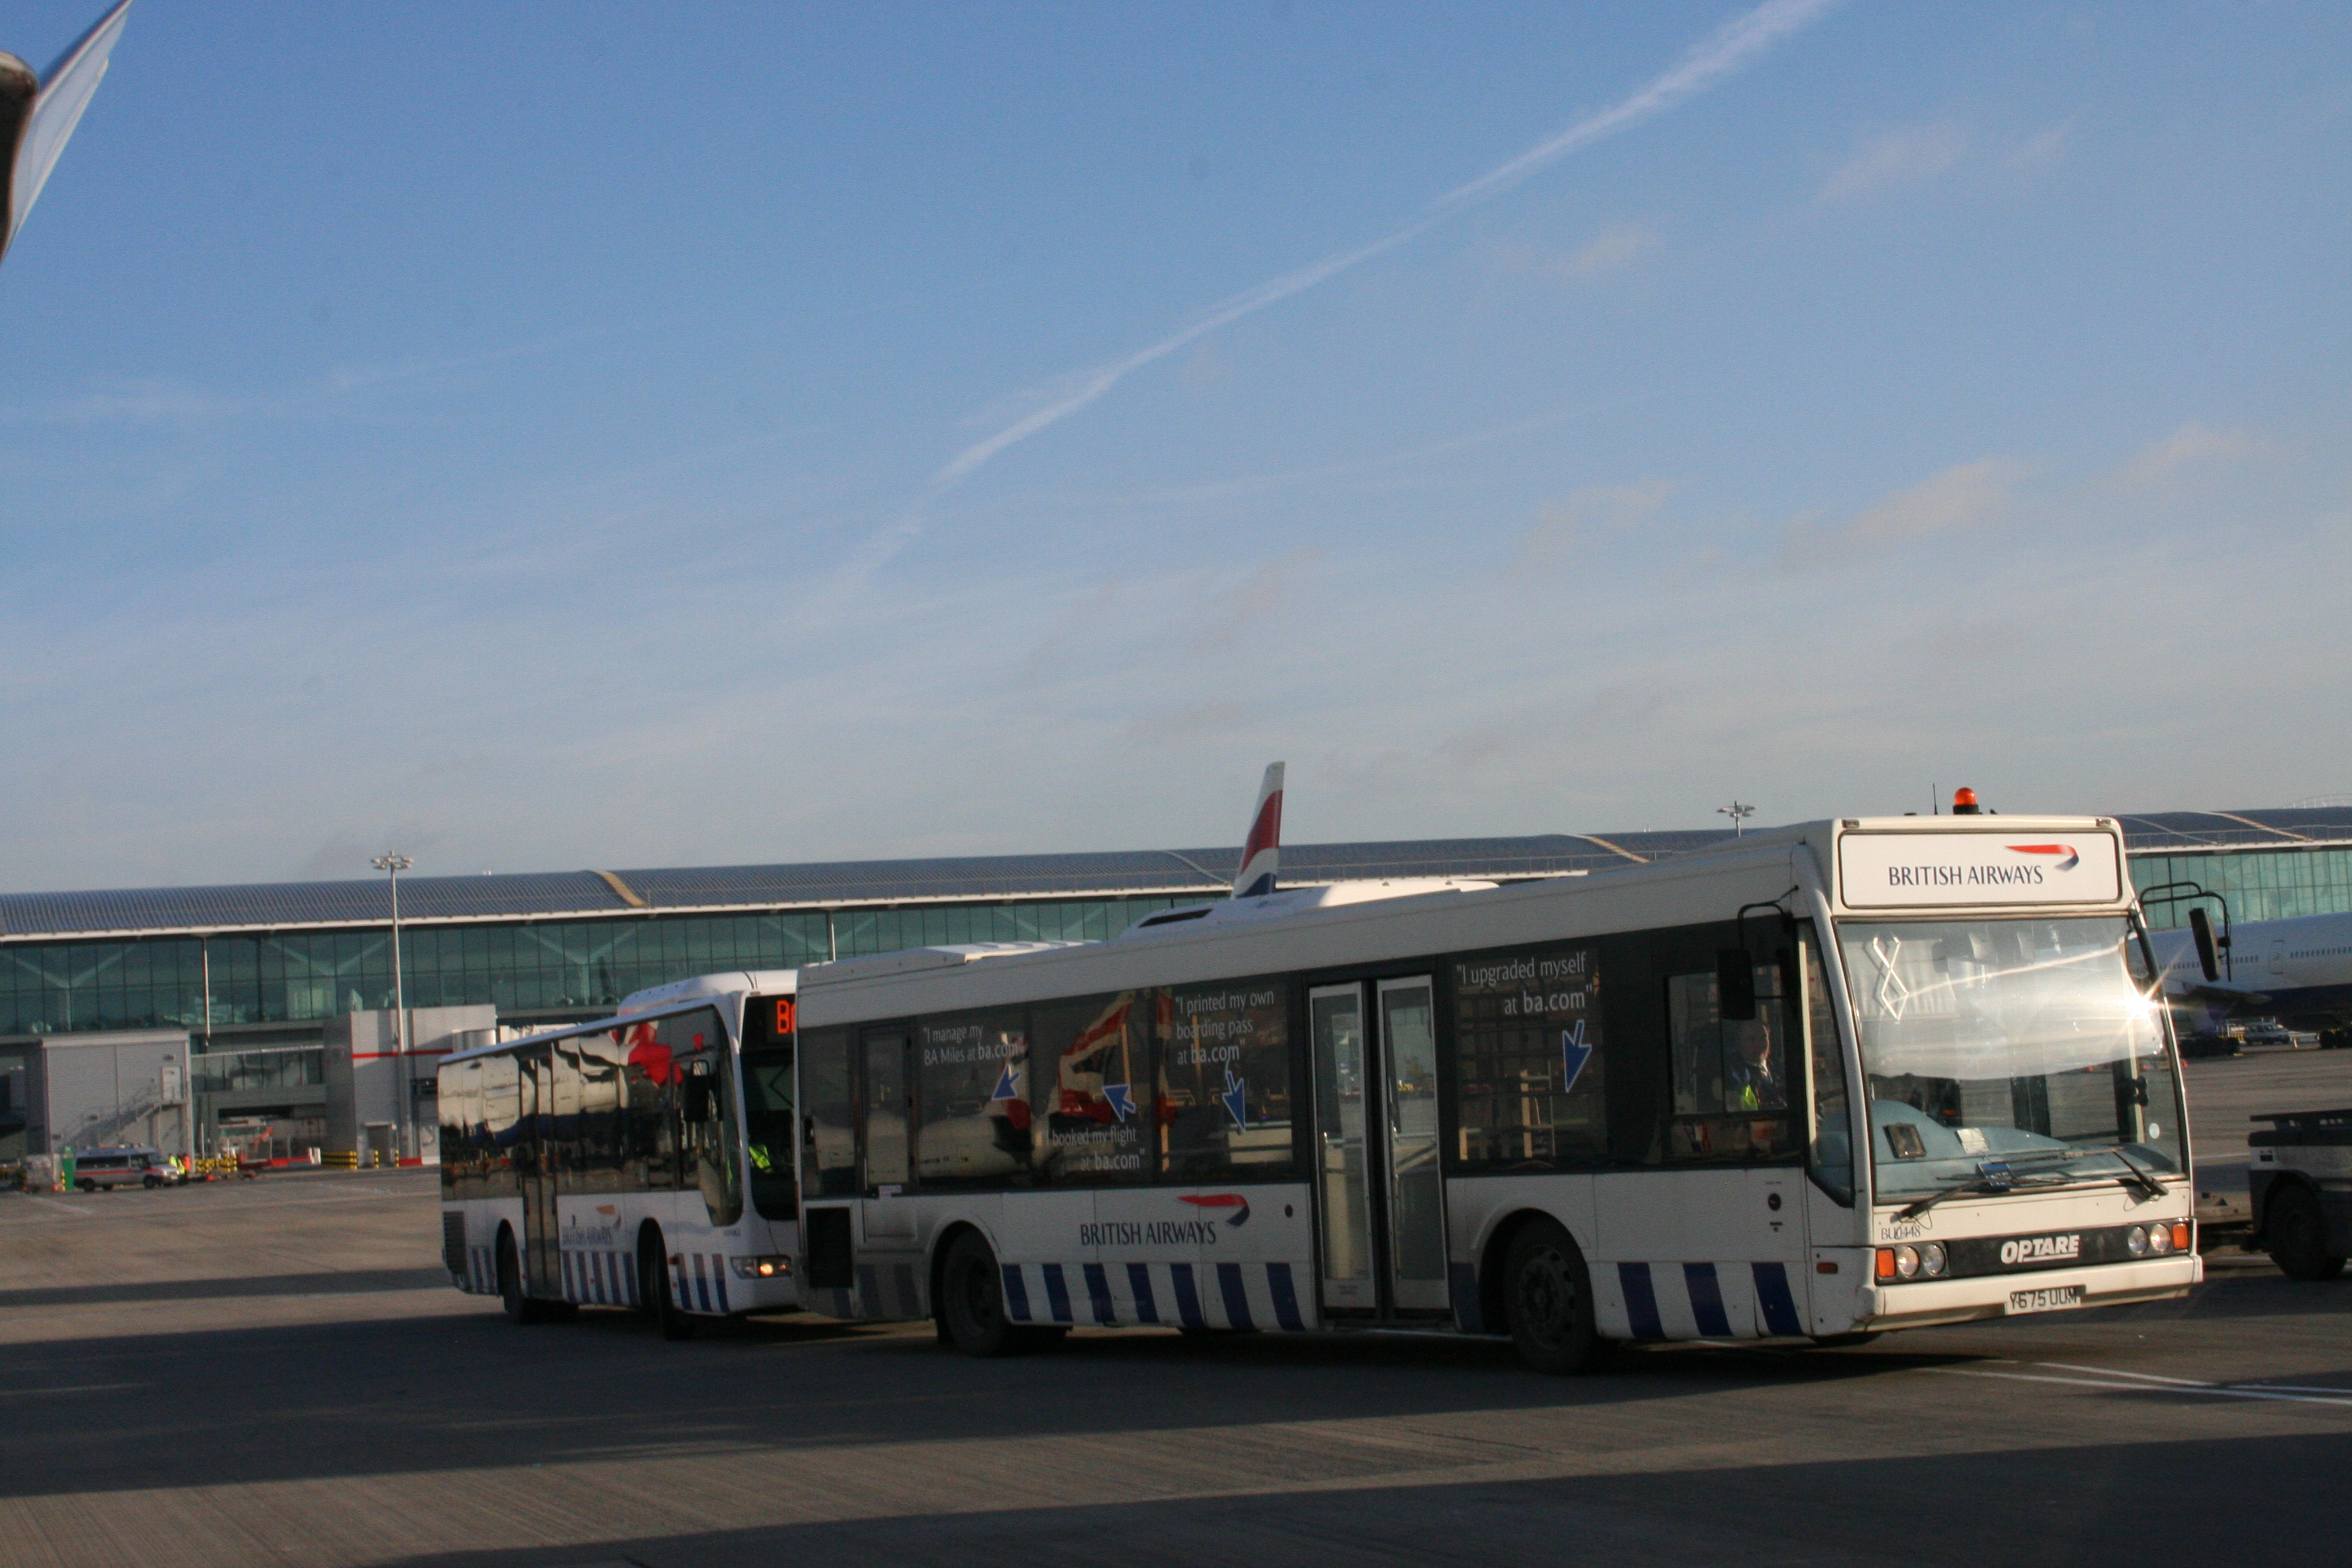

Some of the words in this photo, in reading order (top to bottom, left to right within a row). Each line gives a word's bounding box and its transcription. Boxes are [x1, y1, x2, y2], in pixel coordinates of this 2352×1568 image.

[1889, 866, 1963, 885] BRITISH
[1967, 865, 2043, 884] AIRWAYS
[1471, 957, 1535, 987] upgraded
[1540, 951, 1586, 979] myself
[1187, 992, 1225, 1017] printed
[1230, 994, 1246, 1011] my
[1250, 990, 1274, 1007] own
[1504, 997, 1518, 1015] at
[932, 1027, 967, 1044] manage
[969, 1025, 983, 1040] my
[1176, 1019, 1225, 1039] boarding
[1229, 1020, 1254, 1038] pass
[924, 1049, 938, 1066] BA
[941, 1047, 965, 1063] Miles
[967, 1048, 976, 1062] at
[1177, 1050, 1187, 1066] at
[1052, 1127, 1089, 1146] booked
[1092, 1131, 1108, 1145] my
[1111, 1125, 1137, 1147] flight
[1080, 1158, 1090, 1171] at
[1080, 1222, 1142, 1245] BRITISH
[1146, 1222, 1217, 1245] AIRWAYS
[2001, 1235, 2080, 1264] OPTARE
[2010, 1291, 2046, 1309] Y675
